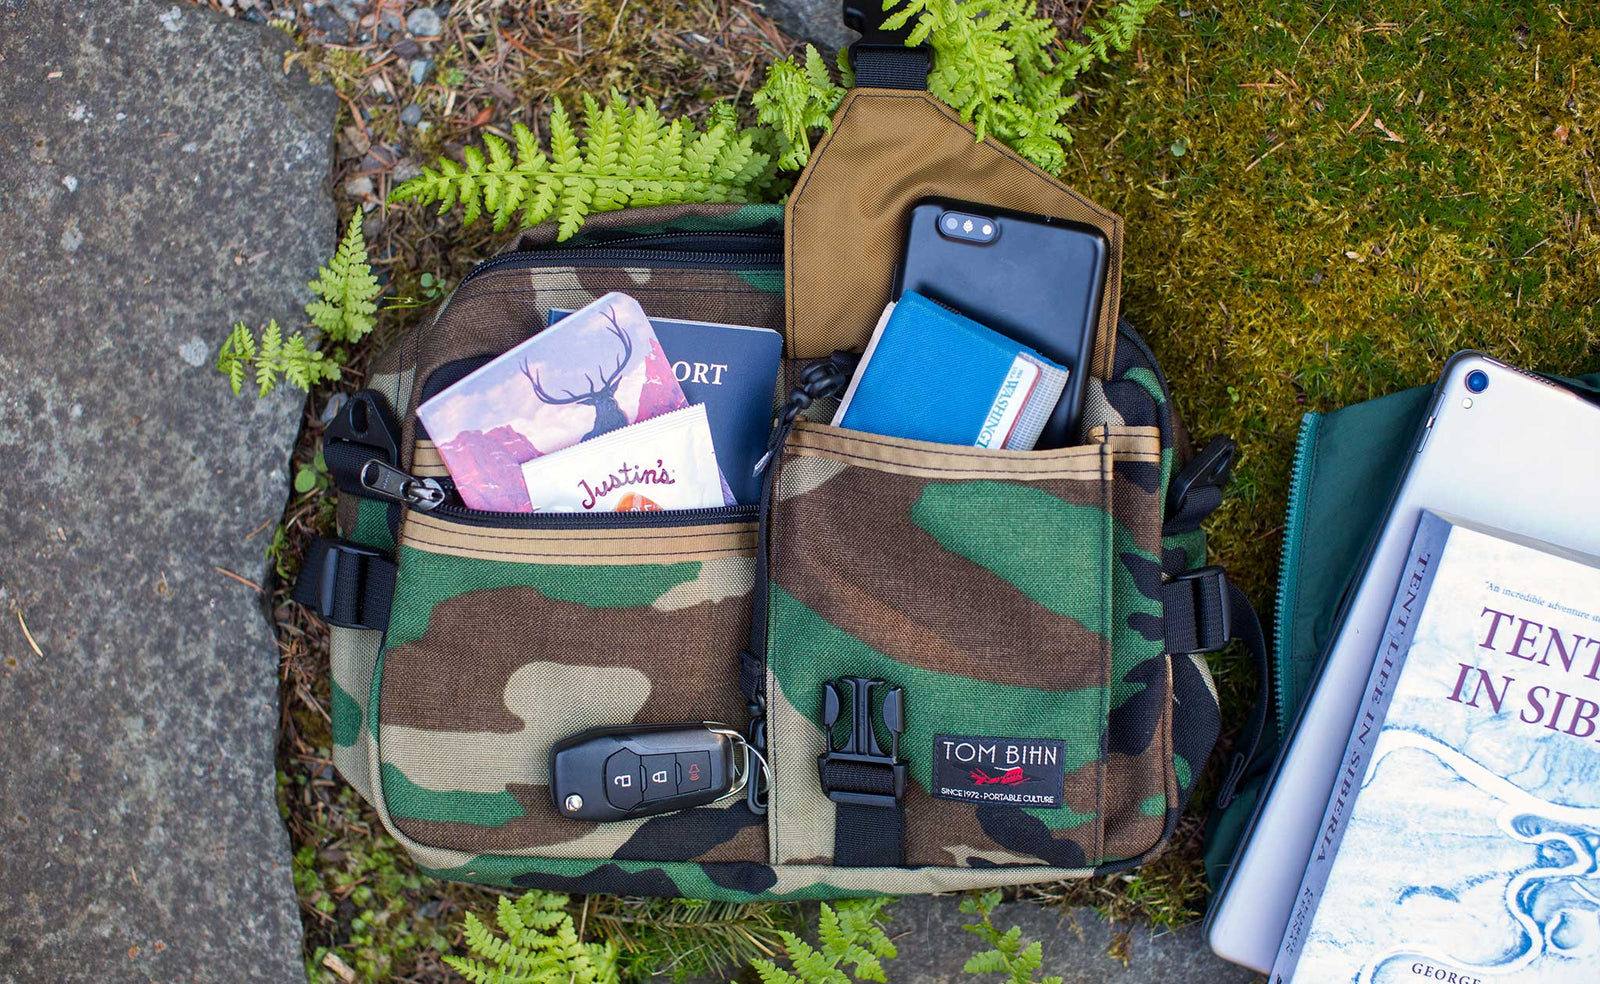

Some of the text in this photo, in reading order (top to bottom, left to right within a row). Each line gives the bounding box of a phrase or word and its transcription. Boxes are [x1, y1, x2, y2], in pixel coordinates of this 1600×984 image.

[577, 459, 676, 510] Justin's
[1502, 588, 1545, 606] incredible
[1547, 601, 1590, 619] adventure
[1316, 553, 1431, 861] TENT LIFE IN SIBERIA
[1446, 662, 1600, 744] IN SIB
[943, 741, 1057, 765] TOM BIHN
[941, 787, 1055, 803] SINCE 1972 PORTABLE CULTURE
